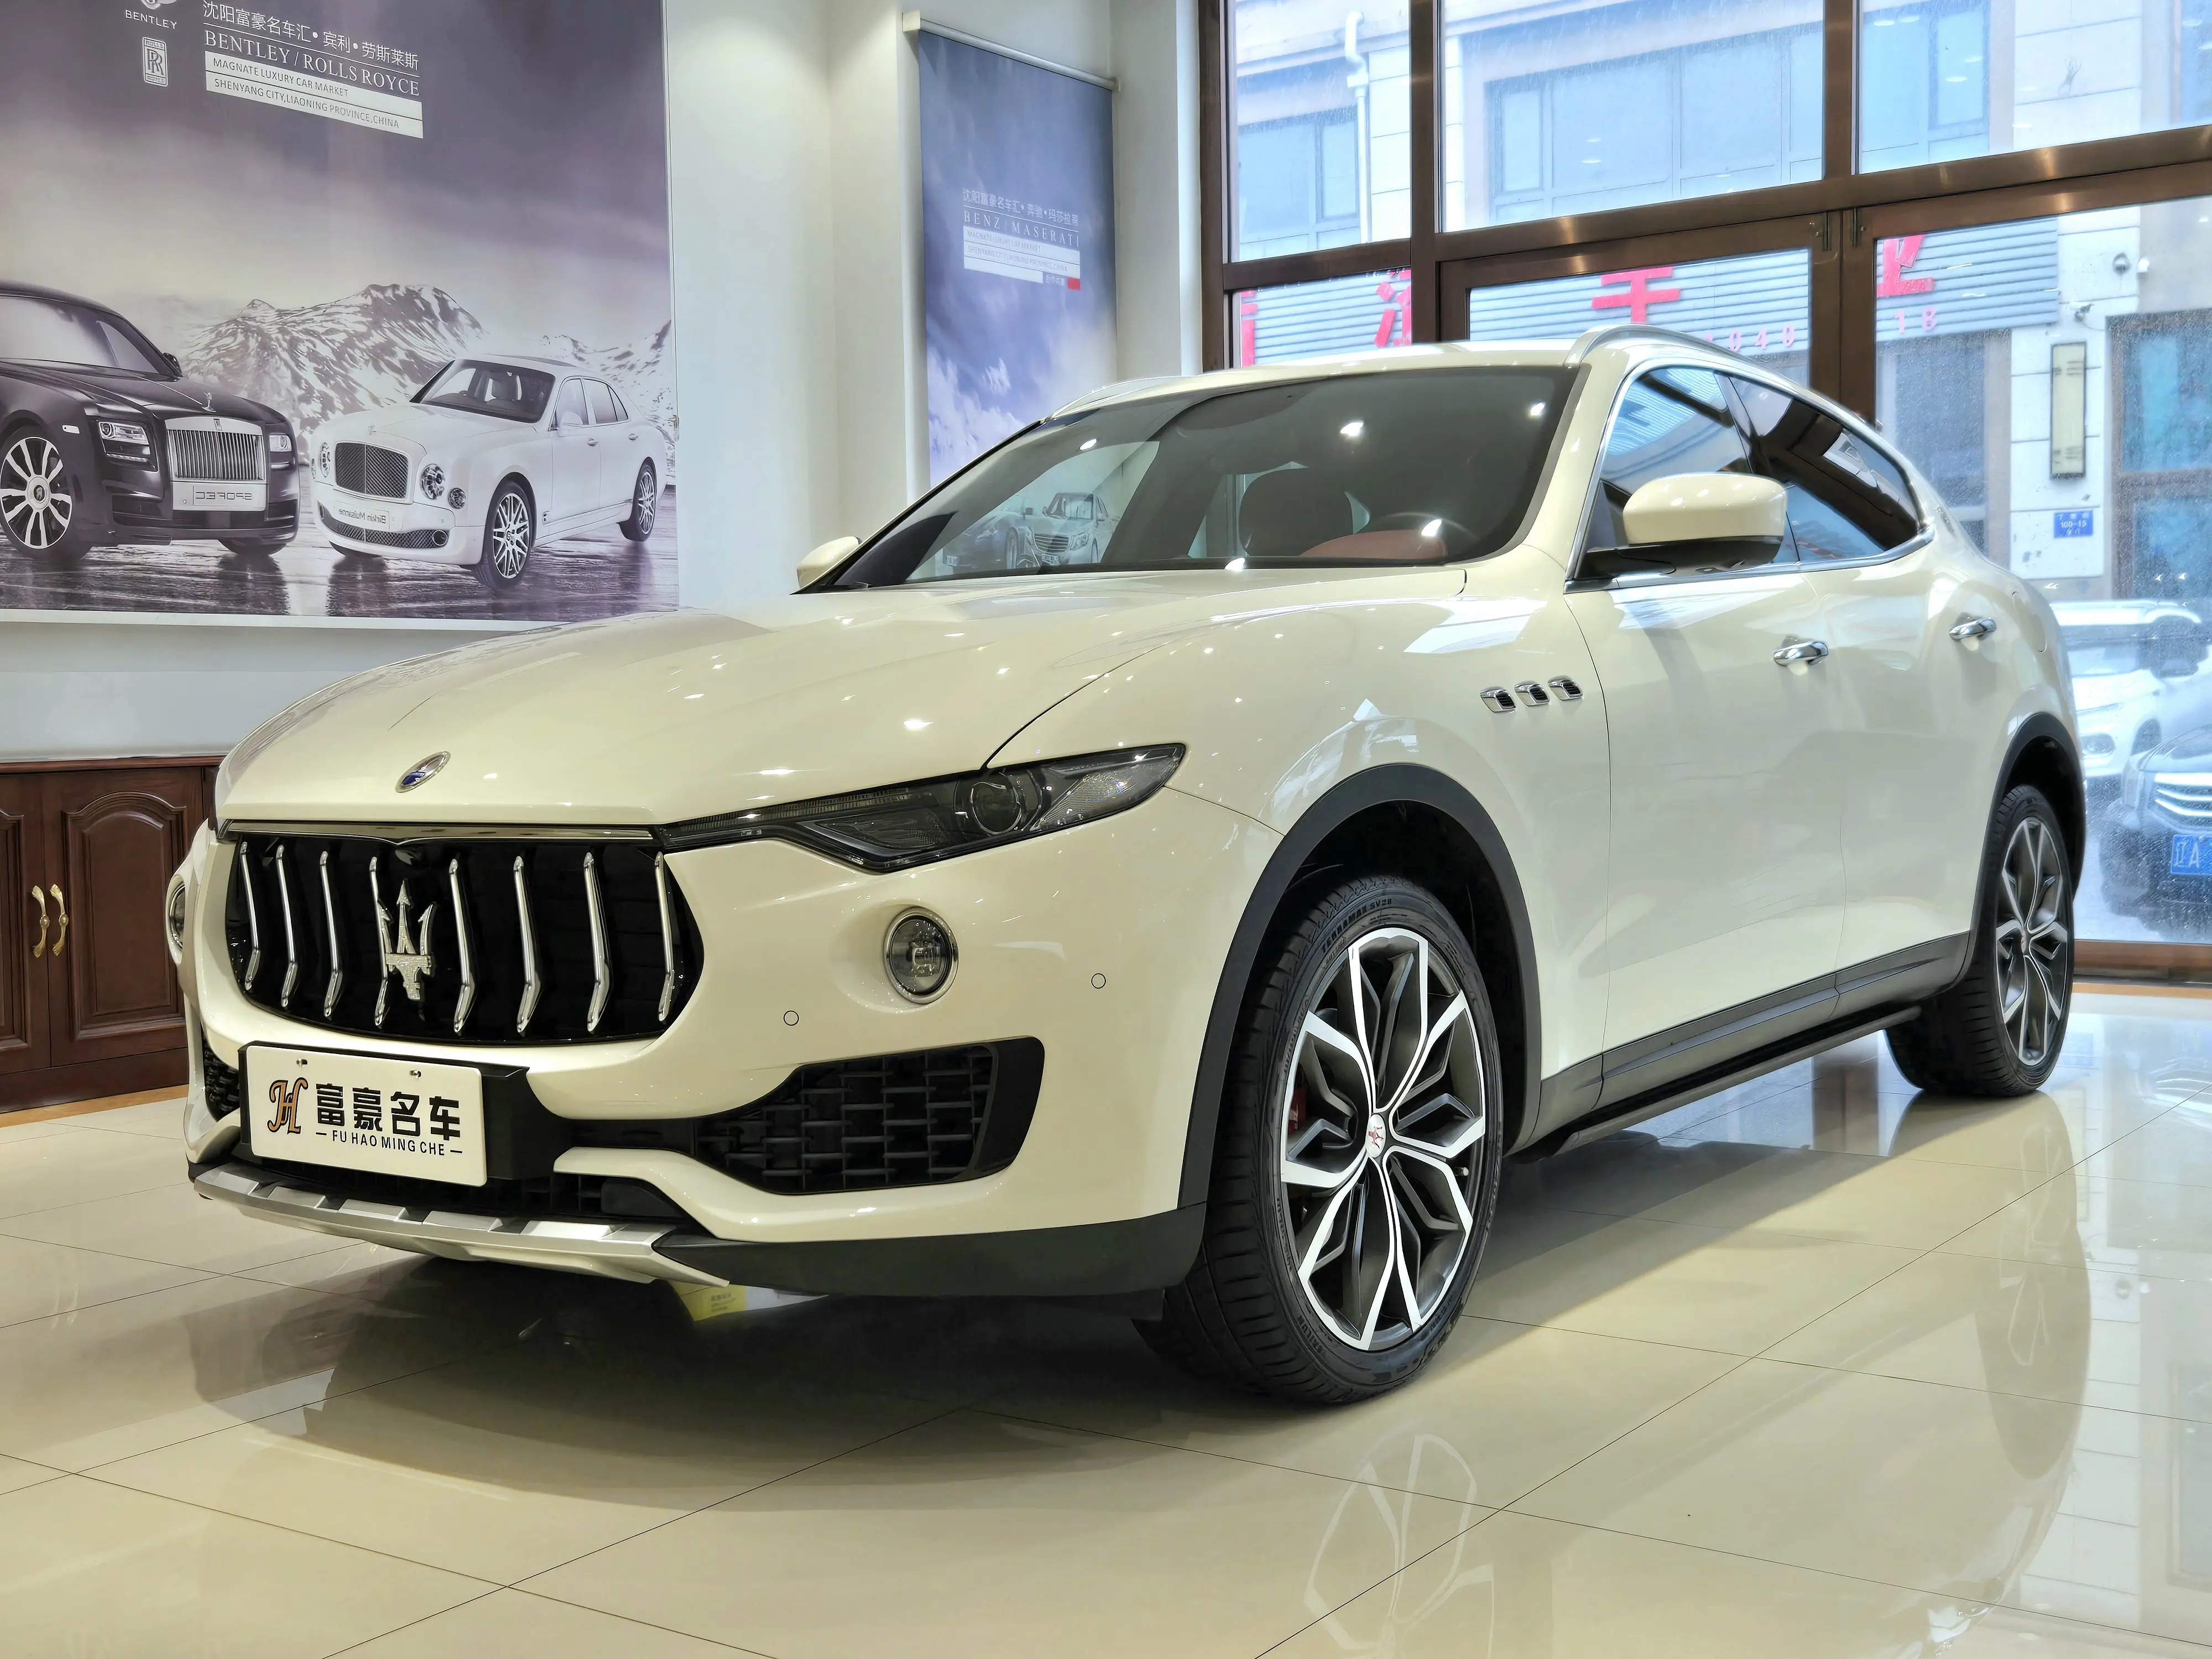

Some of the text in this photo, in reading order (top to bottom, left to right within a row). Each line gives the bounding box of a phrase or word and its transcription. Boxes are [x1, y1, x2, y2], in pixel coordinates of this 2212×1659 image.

[126, 9, 177, 29] BENTLEY
[204, 30, 290, 64] BENTLEY
[303, 53, 358, 81] ROLLS
[361, 69, 420, 96] ROYCE
[213, 58, 348, 97] MAGNATE LUXURY CAR MARKET
[215, 79, 264, 97] SHENYANG
[330, 104, 399, 128] PROVINCE,CHINA
[964, 210, 1000, 229] BENZ
[1013, 221, 1079, 247] MASERATI
[316, 1083, 461, 1141] 富豪名车
[332, 1130, 445, 1156] FU HAO MING CHE
